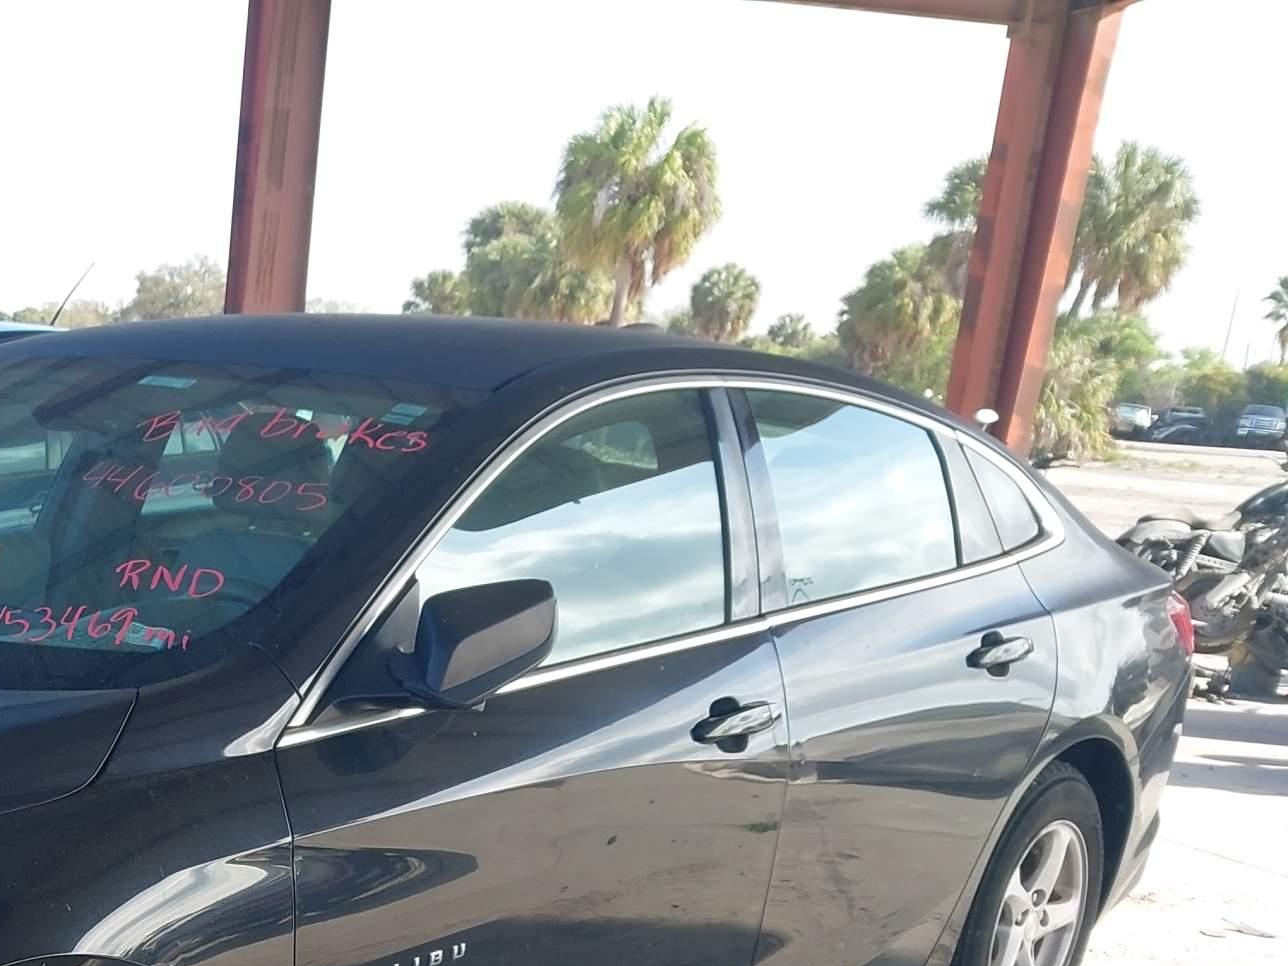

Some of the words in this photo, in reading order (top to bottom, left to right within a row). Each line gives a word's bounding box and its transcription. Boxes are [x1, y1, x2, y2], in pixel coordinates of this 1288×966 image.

[82, 461, 329, 511] 44600805
[115, 559, 226, 598] RND
[144, 625, 192, 650] mi
